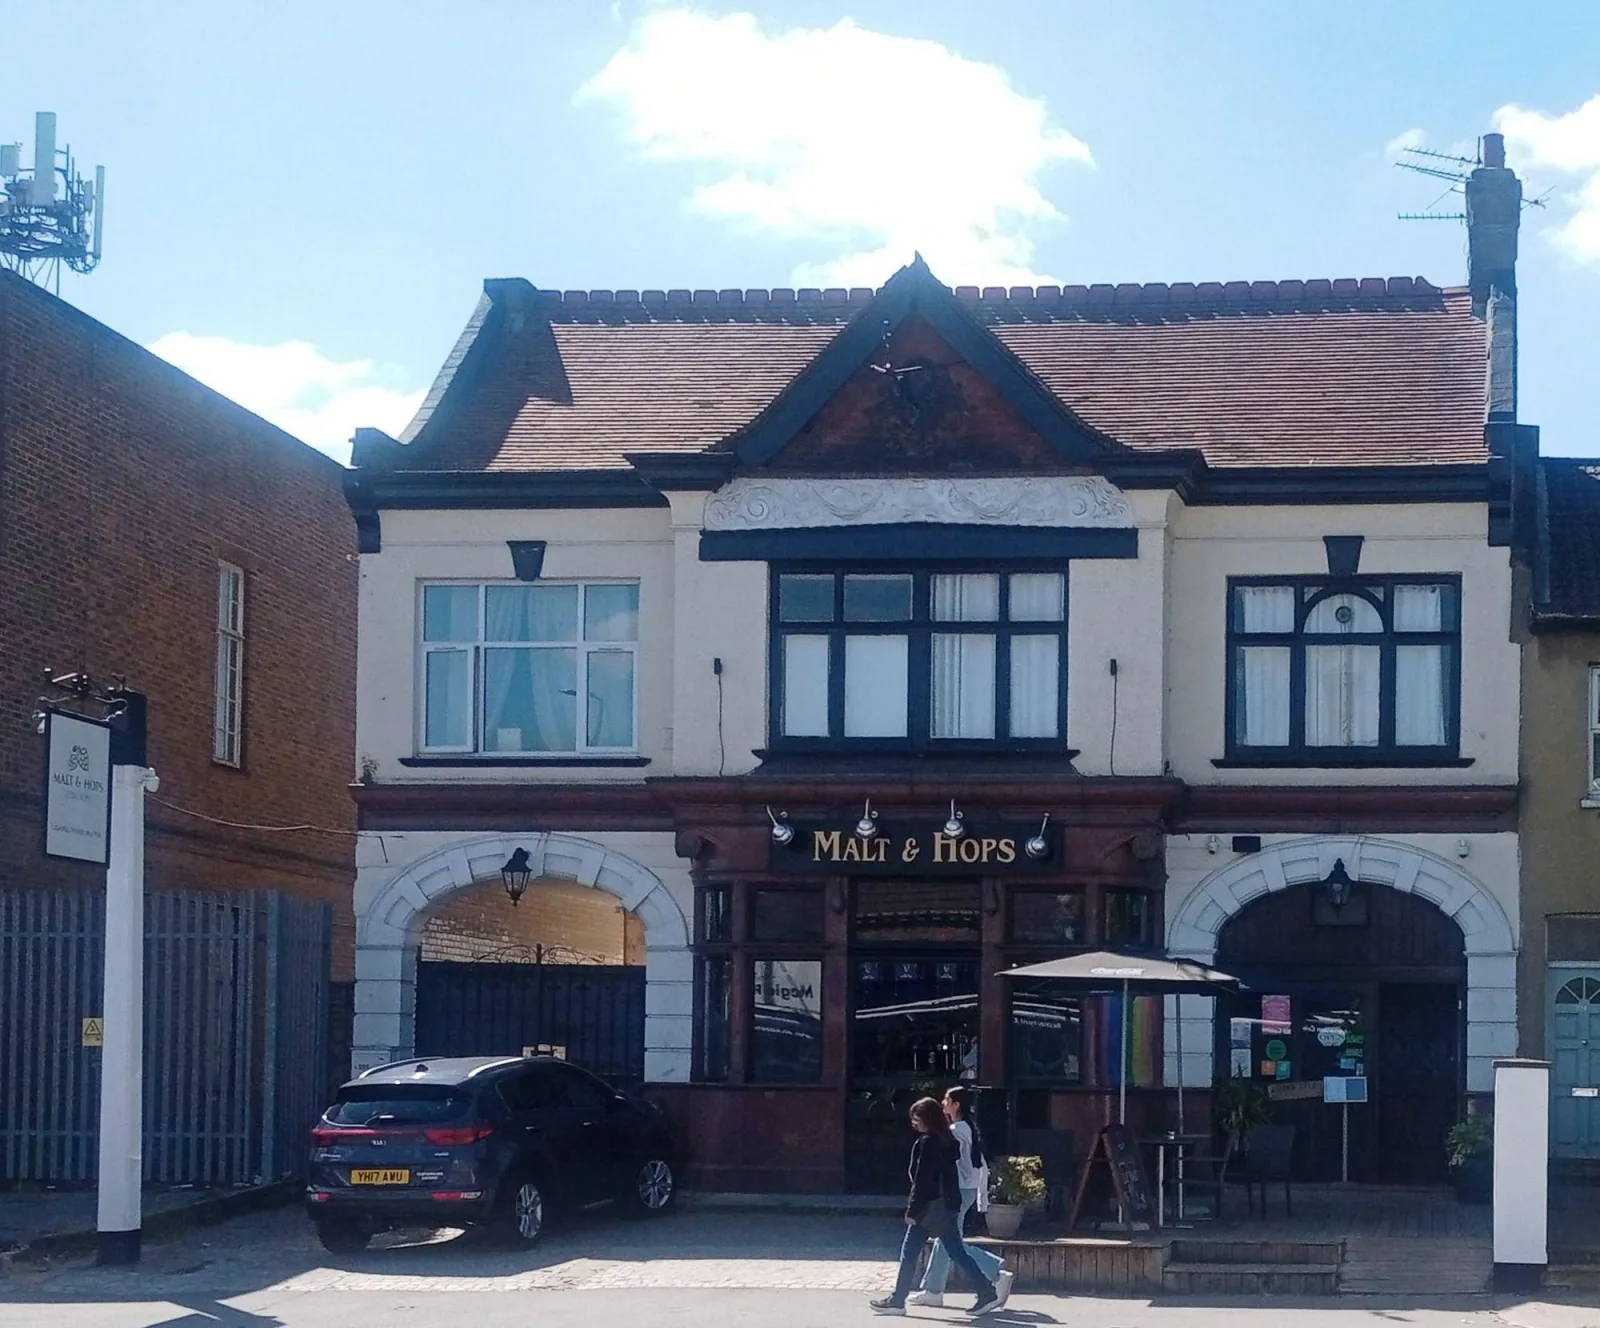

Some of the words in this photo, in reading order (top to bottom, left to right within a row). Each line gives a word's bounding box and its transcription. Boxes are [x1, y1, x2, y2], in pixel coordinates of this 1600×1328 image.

[52, 773, 73, 786] MALT
[813, 831, 890, 862] MALT
[902, 838, 920, 862] &
[933, 831, 1016, 863] HOPS
[357, 1171, 380, 1183] YH17
